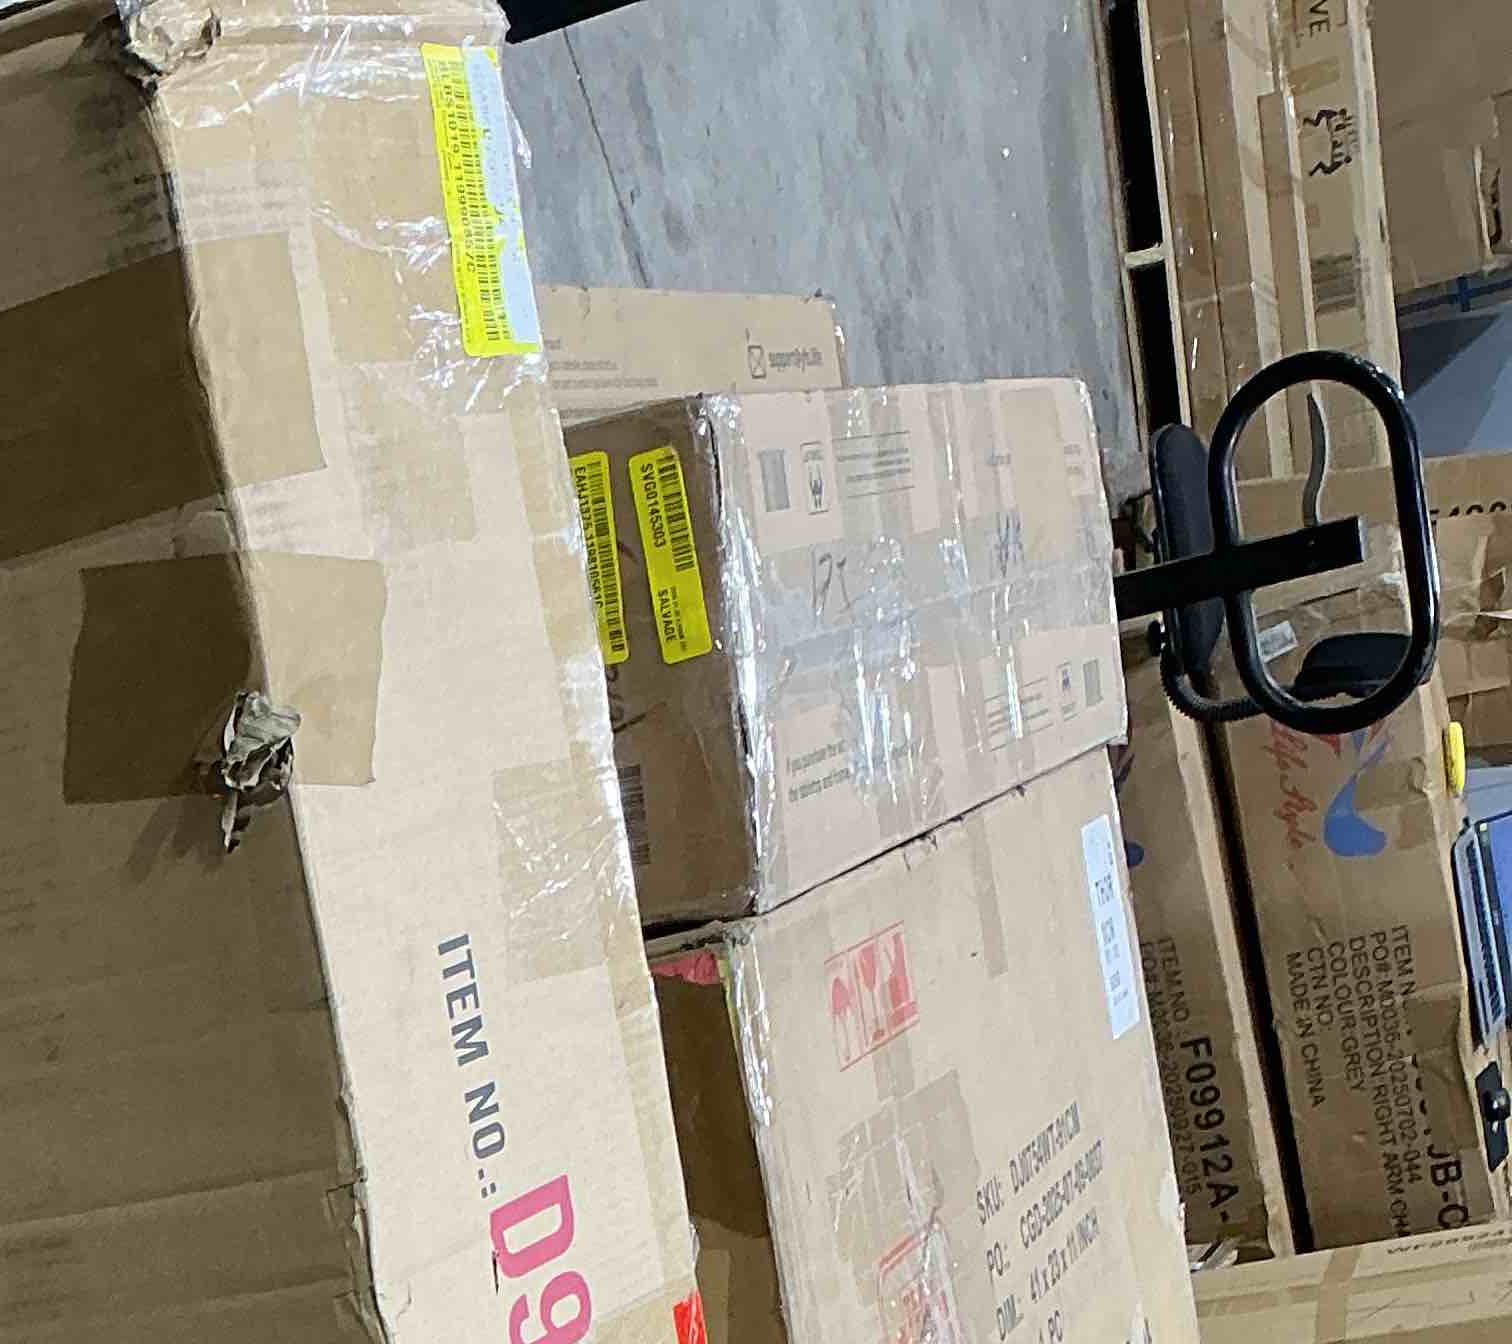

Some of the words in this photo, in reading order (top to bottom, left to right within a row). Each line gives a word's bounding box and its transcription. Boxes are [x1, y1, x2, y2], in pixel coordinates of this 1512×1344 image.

[1307, 947, 1328, 997] CTN
[1392, 925, 1413, 978] ITEM
[437, 933, 489, 1066] ITEM
[1286, 951, 1311, 1013] MADE
[1296, 1018, 1313, 1039] IN
[1300, 1044, 1326, 1109] CHINA
[1382, 1151, 1406, 1199] ARM
